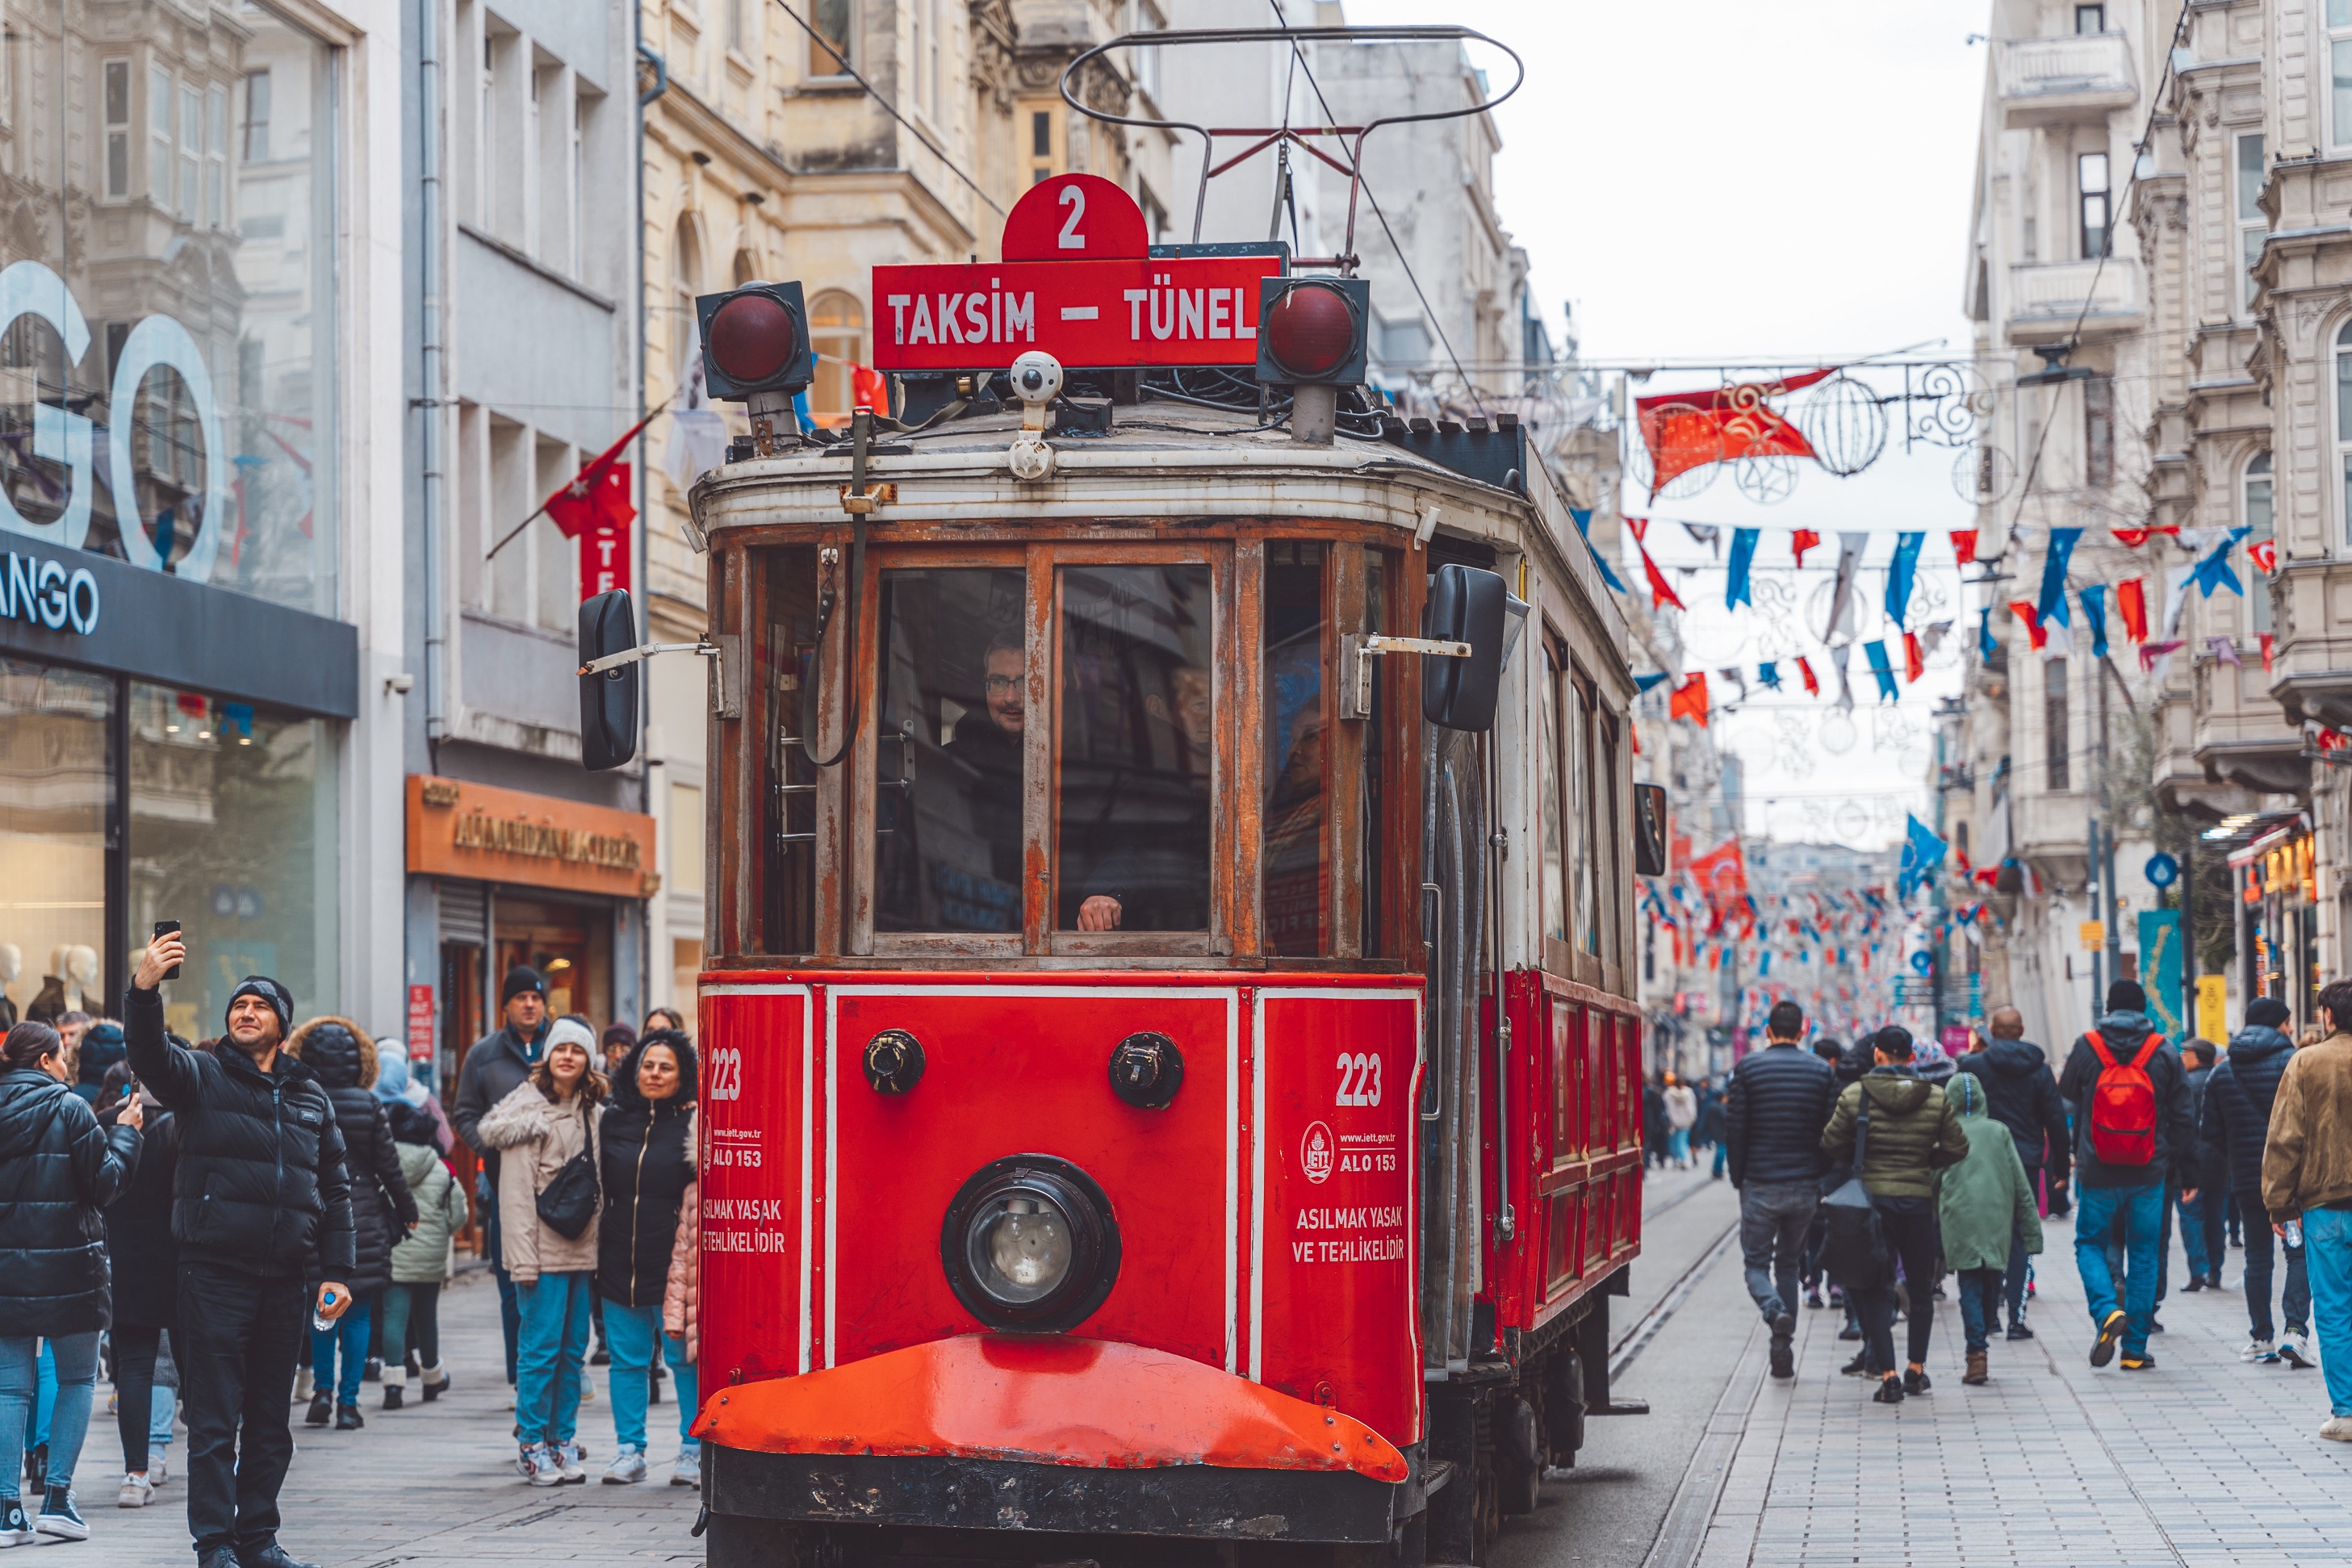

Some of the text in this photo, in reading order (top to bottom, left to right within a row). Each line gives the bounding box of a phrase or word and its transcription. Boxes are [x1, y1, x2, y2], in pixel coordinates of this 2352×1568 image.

[1058, 185, 1086, 249] 2
[887, 277, 1036, 345] TAKSİM
[1124, 273, 1257, 341] TÜNEL
[711, 1047, 741, 1101] 223
[1336, 1052, 1382, 1106] 223
[714, 1128, 762, 1140] www.iett.gov.tr
[1340, 1133, 1396, 1144] www.iett.gov.tr
[714, 1149, 733, 1166] ALO
[736, 1150, 761, 1168] 153
[1340, 1154, 1396, 1172] ALO 153
[736, 1199, 781, 1220] YASAK
[1296, 1206, 1403, 1229] ASILMAK YASAK
[708, 1227, 785, 1252] TEHLİKELİDİR
[1292, 1235, 1404, 1262] VE TEHLİKELİDİR
